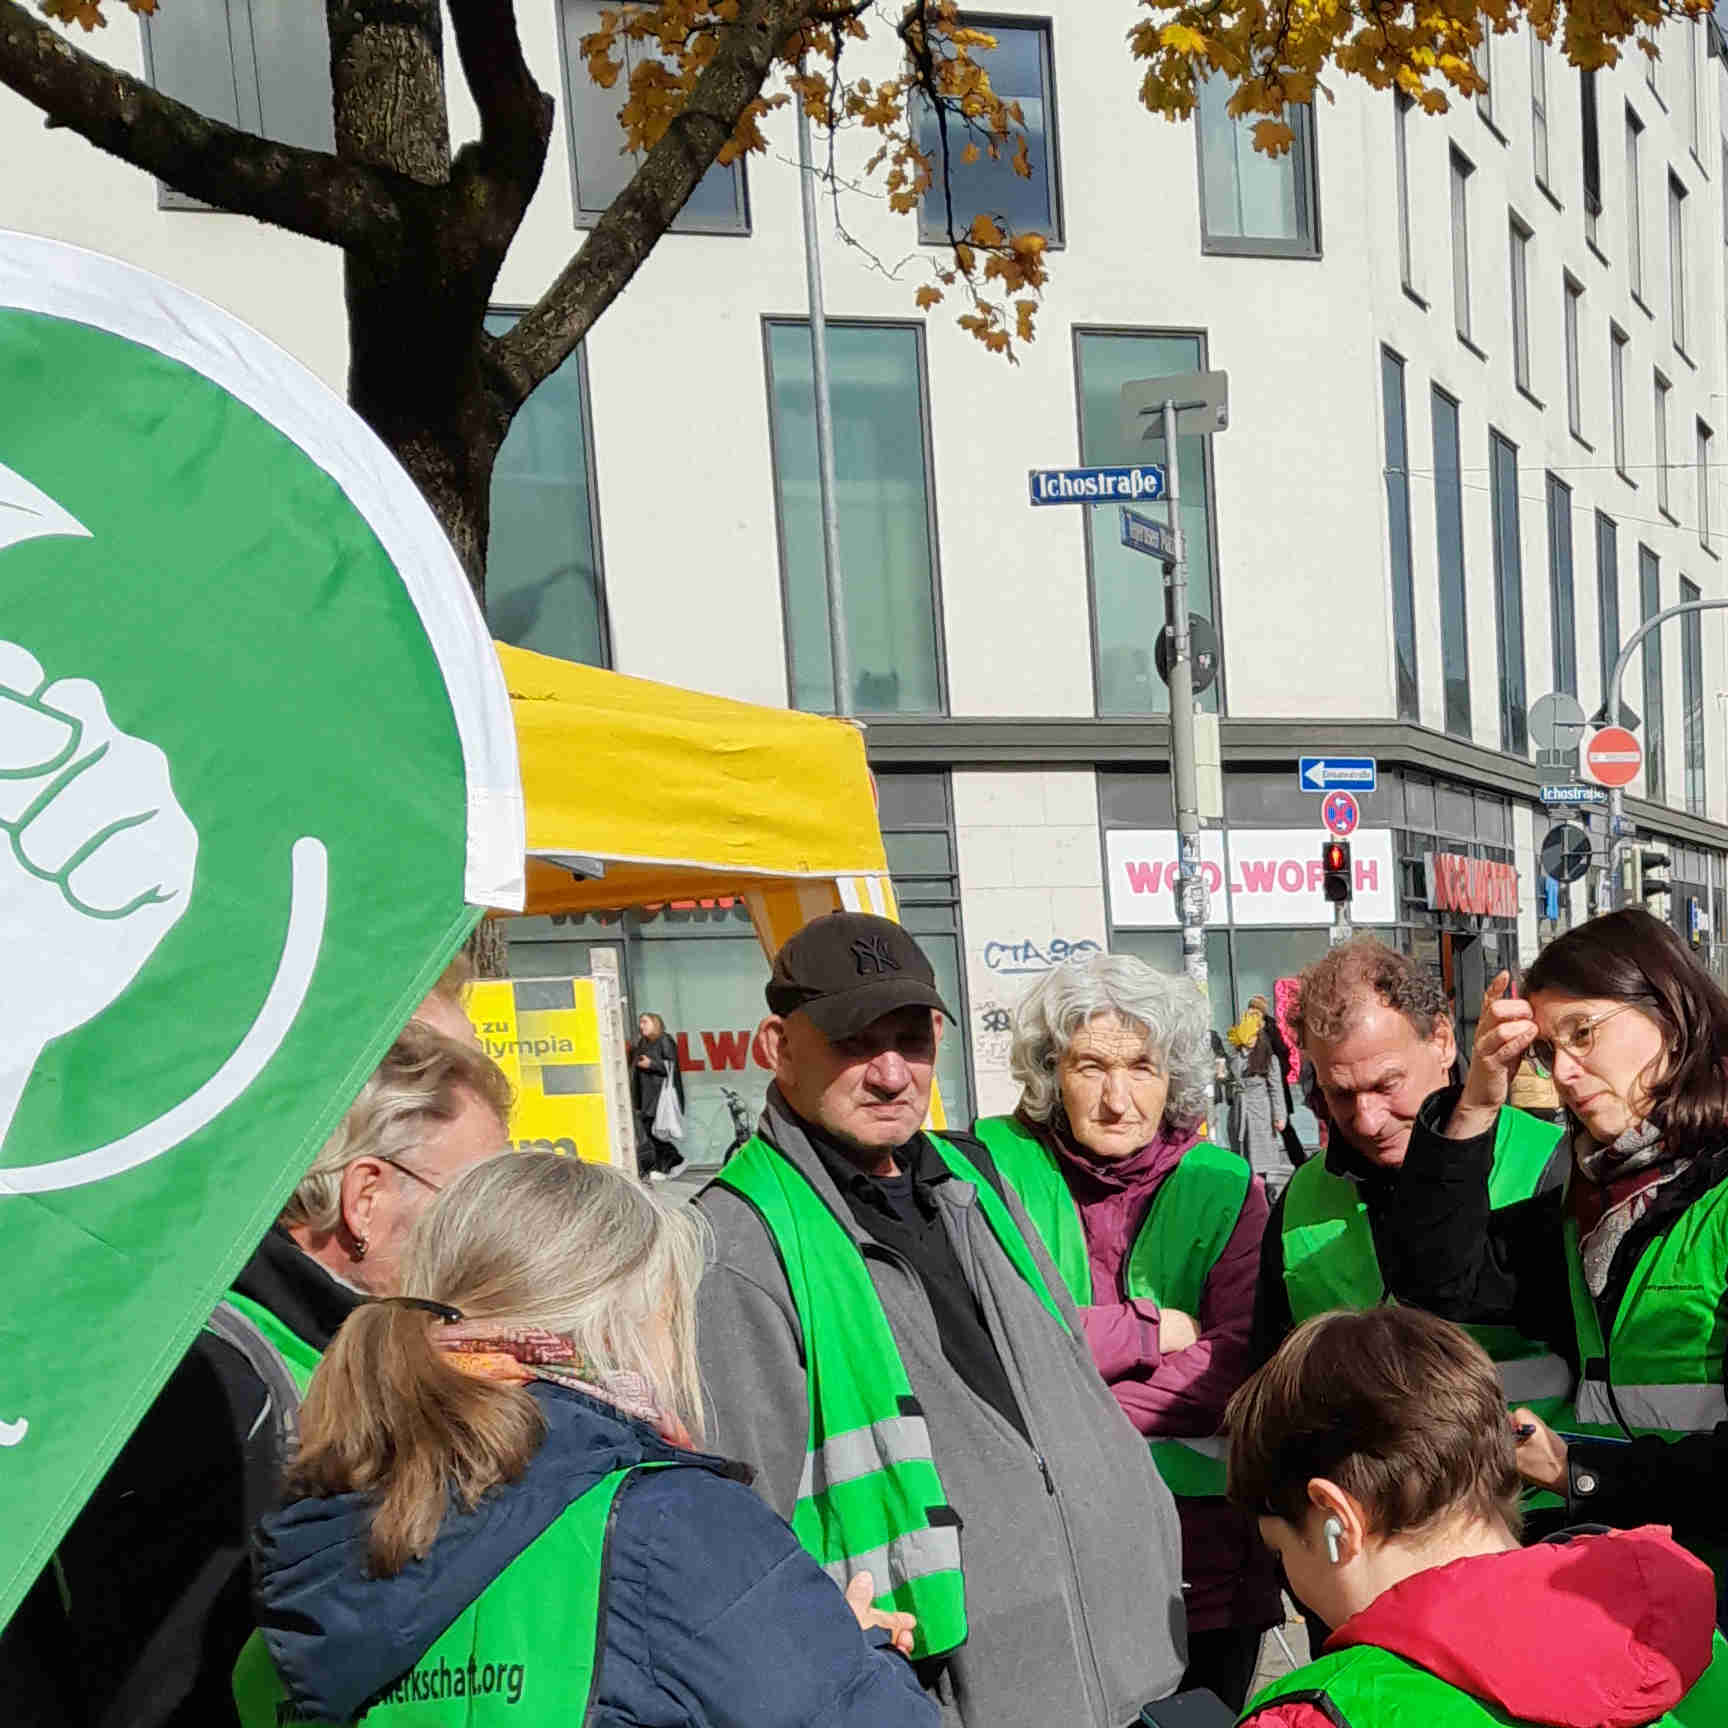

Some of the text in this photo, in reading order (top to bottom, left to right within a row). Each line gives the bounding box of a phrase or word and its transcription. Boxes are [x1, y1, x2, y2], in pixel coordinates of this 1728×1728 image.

[1039, 469, 1158, 498] Ichostraße
[481, 1021, 509, 1034] zu
[480, 1035, 574, 1057] lympia
